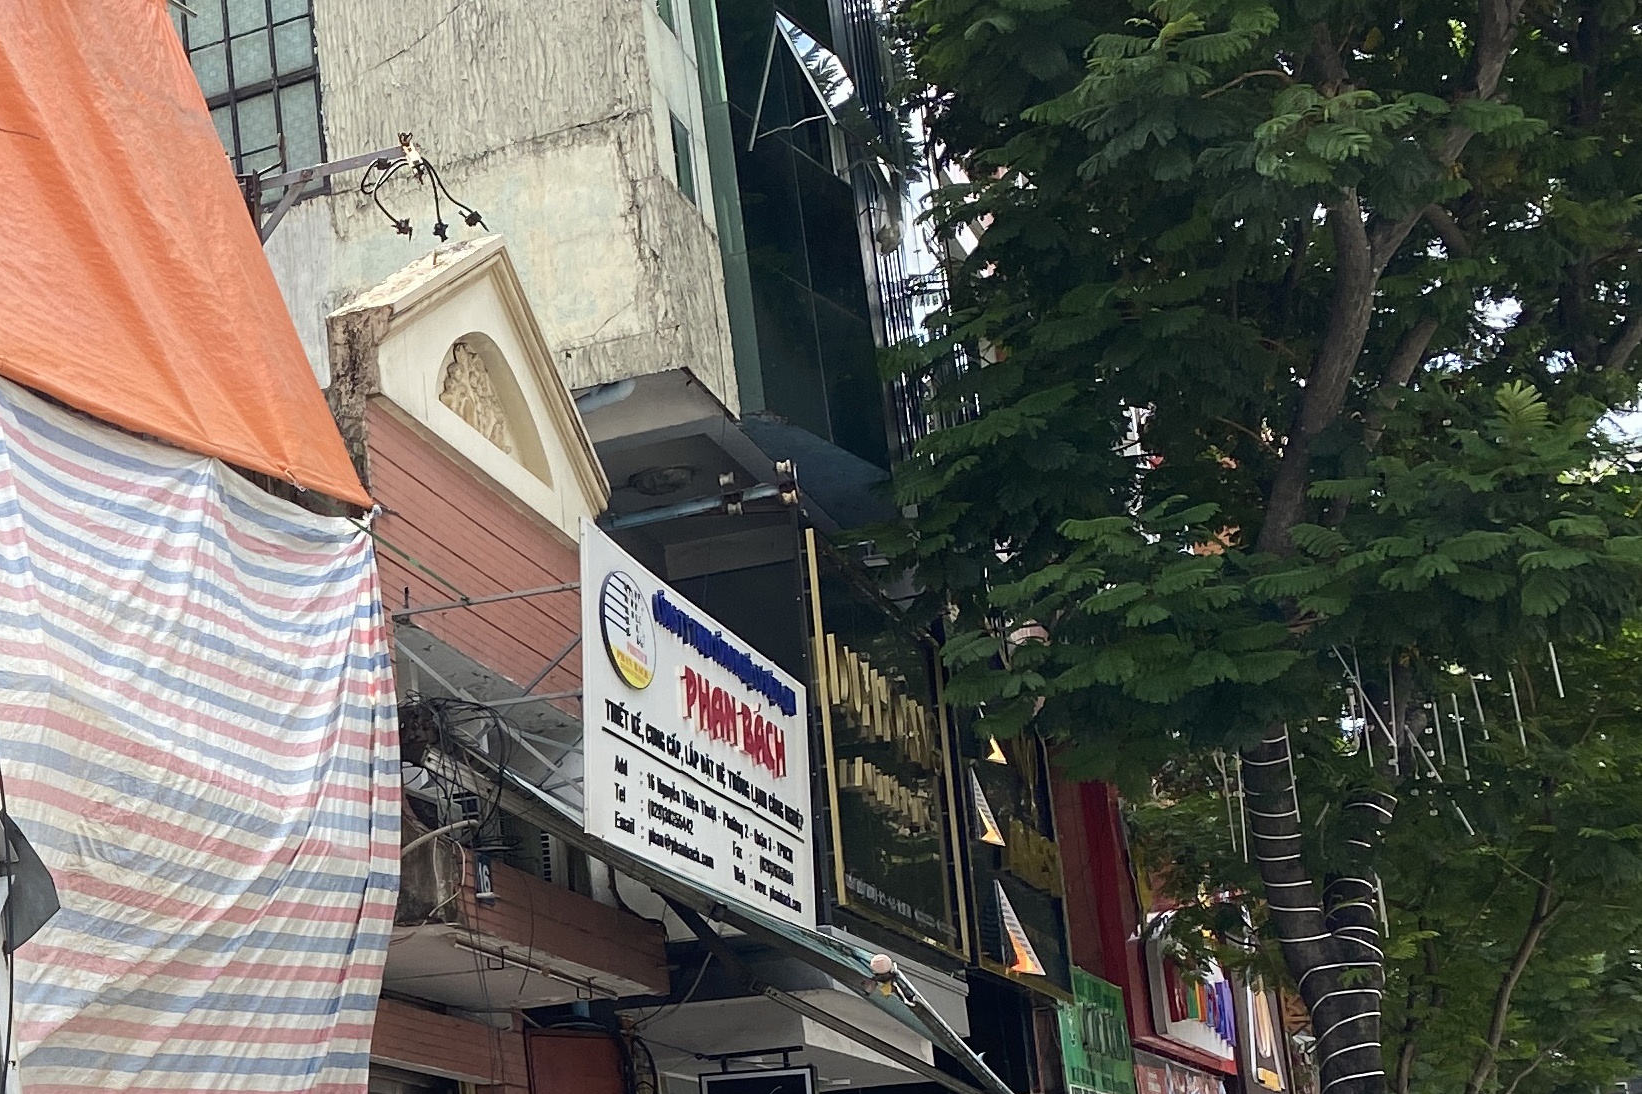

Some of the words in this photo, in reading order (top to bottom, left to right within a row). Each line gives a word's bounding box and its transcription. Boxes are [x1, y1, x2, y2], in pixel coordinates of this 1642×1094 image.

[680, 665, 738, 747] PHAN
[737, 703, 787, 779] BÁCH
[614, 782, 627, 804] Tel
